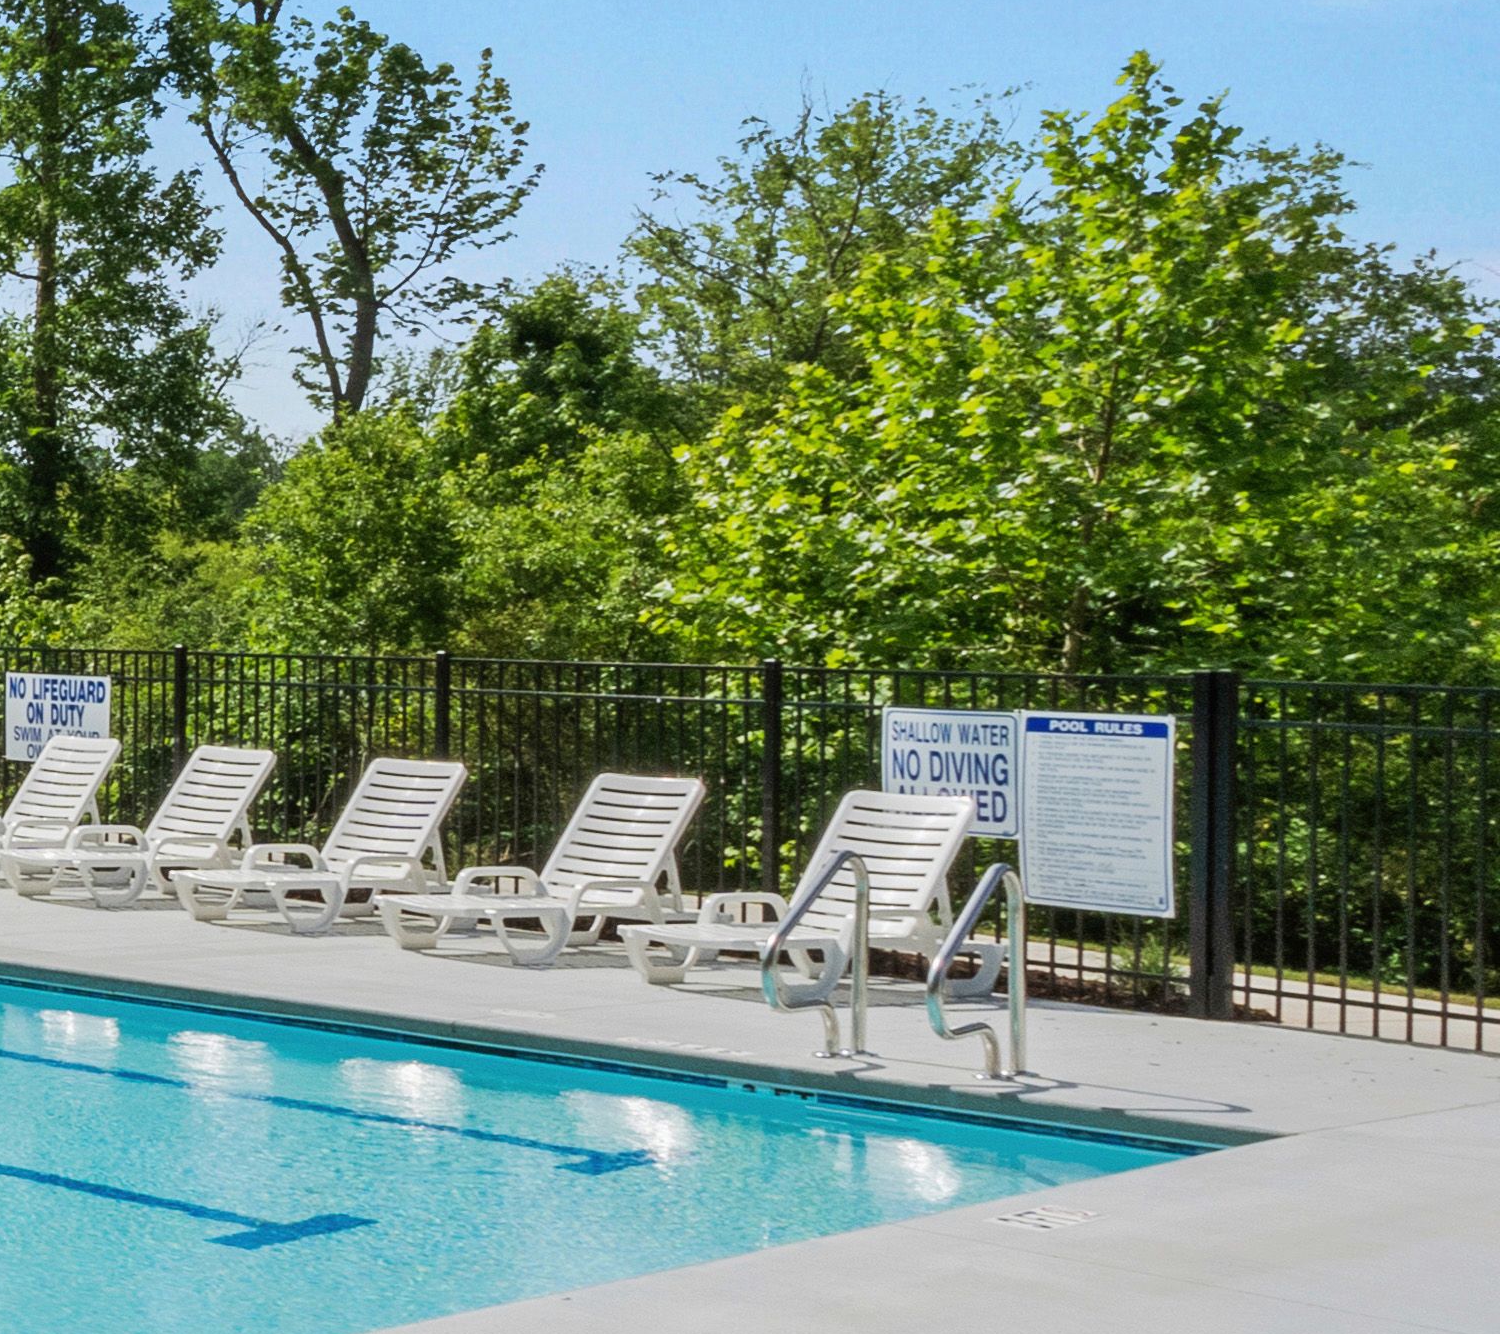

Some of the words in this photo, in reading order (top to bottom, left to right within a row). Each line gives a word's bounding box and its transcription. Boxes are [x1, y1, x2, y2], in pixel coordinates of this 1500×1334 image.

[9, 677, 26, 699] NO
[33, 678, 106, 703] LIFEGUARD
[26, 702, 44, 724] ON
[51, 704, 85, 727] DUTY
[14, 726, 42, 742] SWIM
[892, 721, 952, 744] SHALLOW
[957, 723, 1010, 746] WATER
[1049, 720, 1088, 732] POOL
[1094, 723, 1143, 735] RULES
[892, 749, 920, 781] NO
[929, 750, 1009, 786] DIVING
